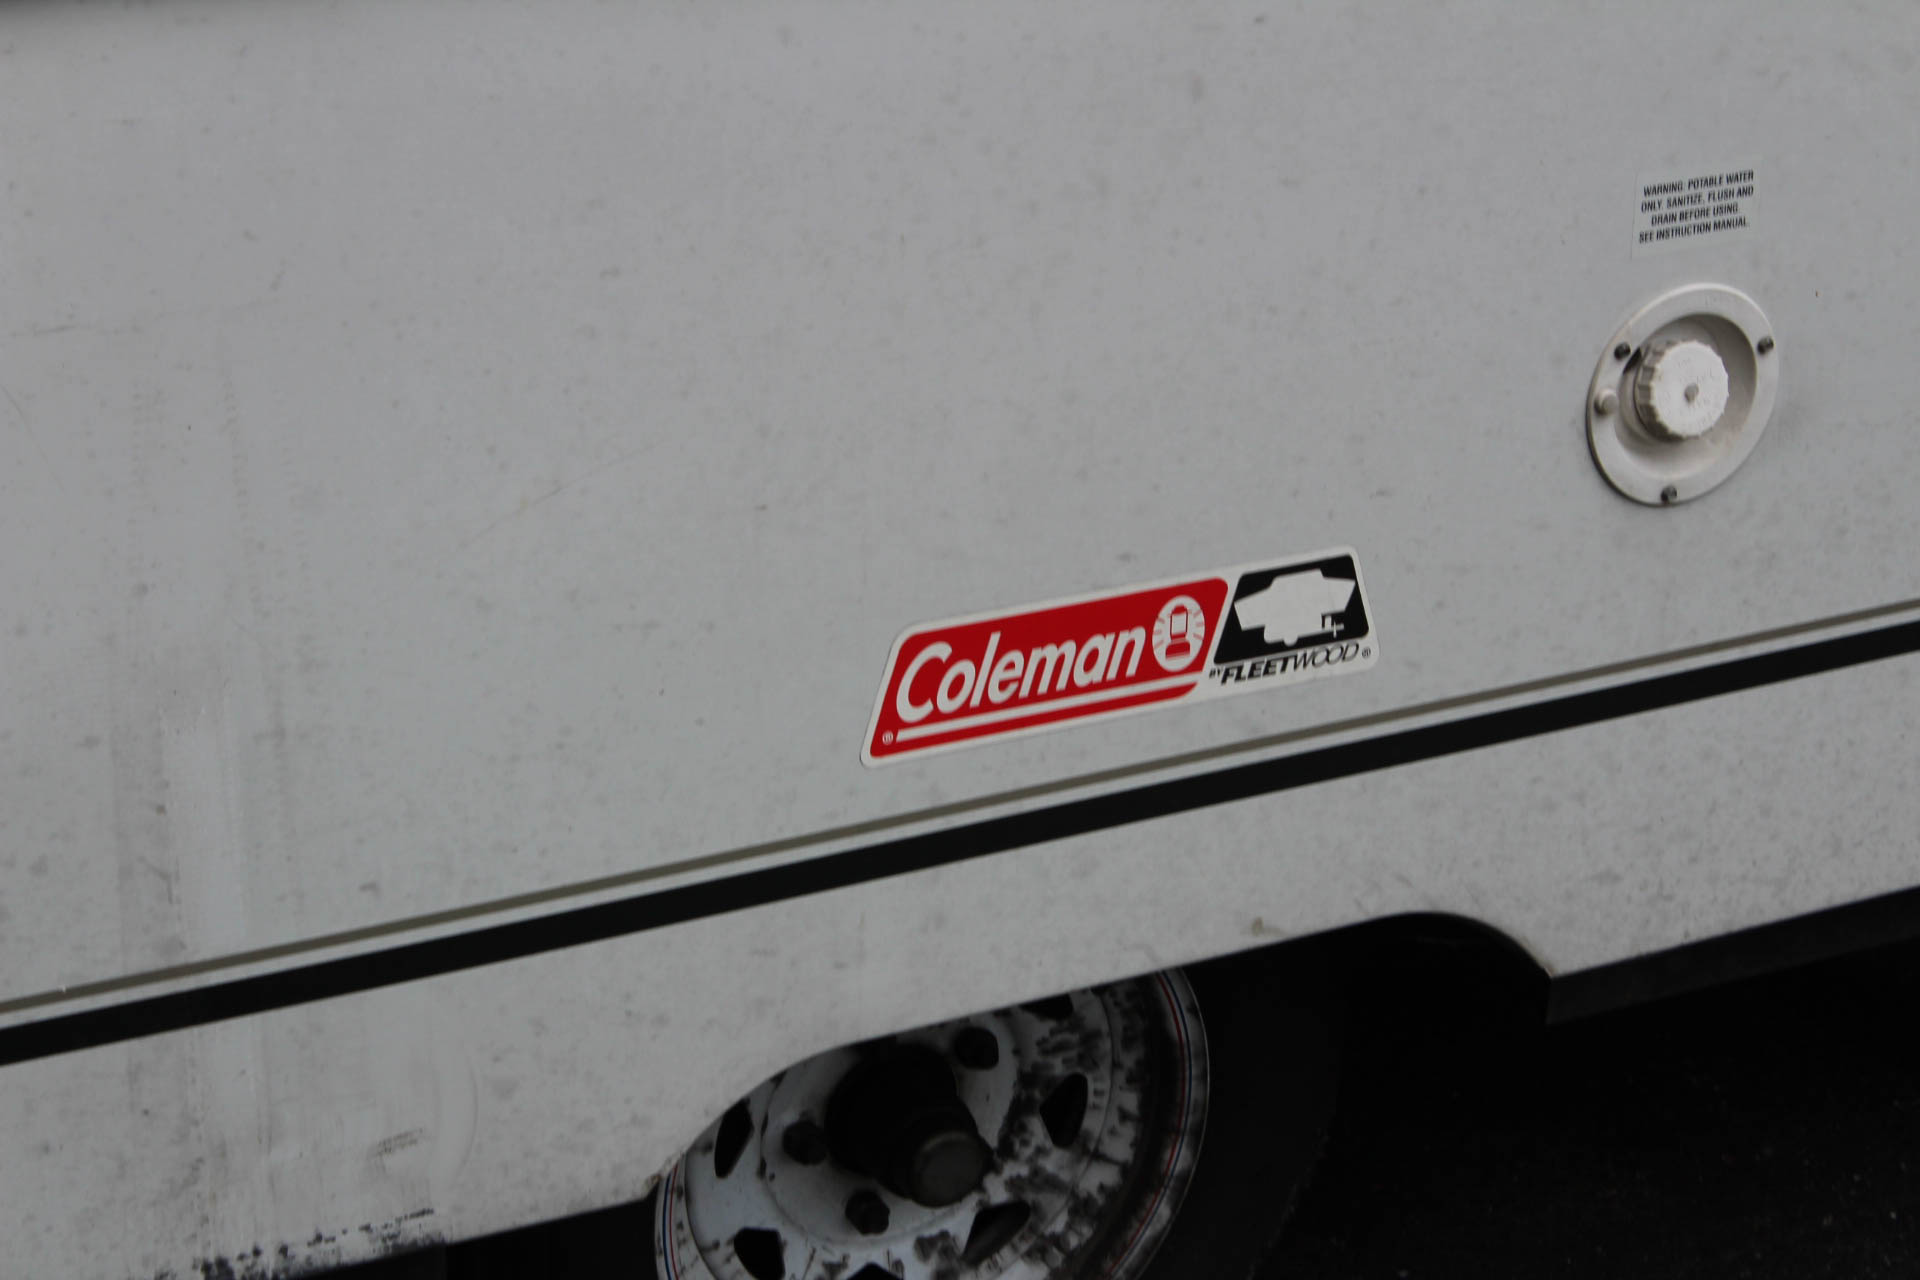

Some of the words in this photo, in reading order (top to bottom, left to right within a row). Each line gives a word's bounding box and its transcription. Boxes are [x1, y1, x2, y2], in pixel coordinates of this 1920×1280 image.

[1688, 174, 1724, 191] POTABLE
[1726, 168, 1754, 185] WATER
[1708, 186, 1735, 203] FLUSH
[1736, 184, 1754, 199] AND
[1651, 212, 1677, 227] DRAIN
[1679, 207, 1711, 222] BEFORE
[1639, 230, 1654, 244] SEE
[1656, 222, 1711, 241] INSTRUCTION
[896, 627, 1146, 722] Coleman
